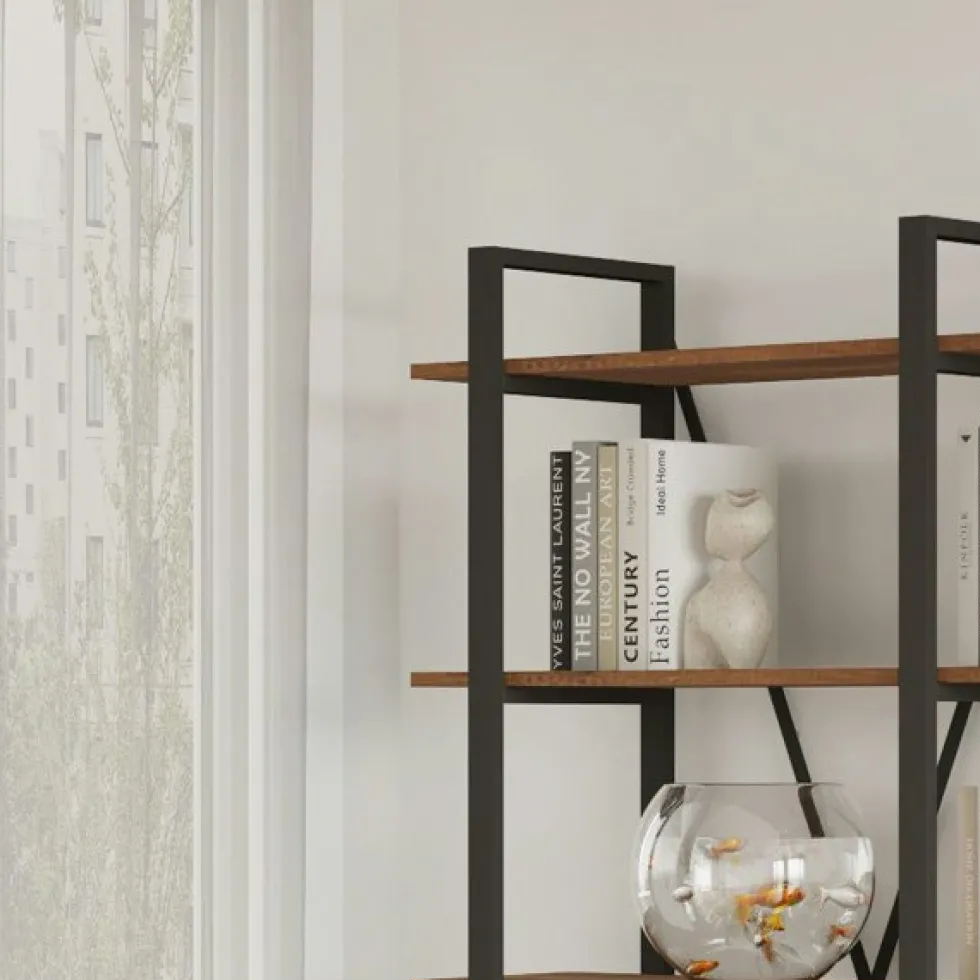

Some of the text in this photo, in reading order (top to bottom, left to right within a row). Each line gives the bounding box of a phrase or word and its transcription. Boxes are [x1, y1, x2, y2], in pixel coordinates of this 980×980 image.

[600, 467, 613, 641] EUROPEAN ART
[656, 449, 666, 516] Ideal Home
[553, 456, 563, 670] YVES SAINT LAURENT
[575, 450, 591, 661] THE NO WALL NY
[624, 551, 639, 663] CENTURY
[650, 568, 670, 664] Fashion
